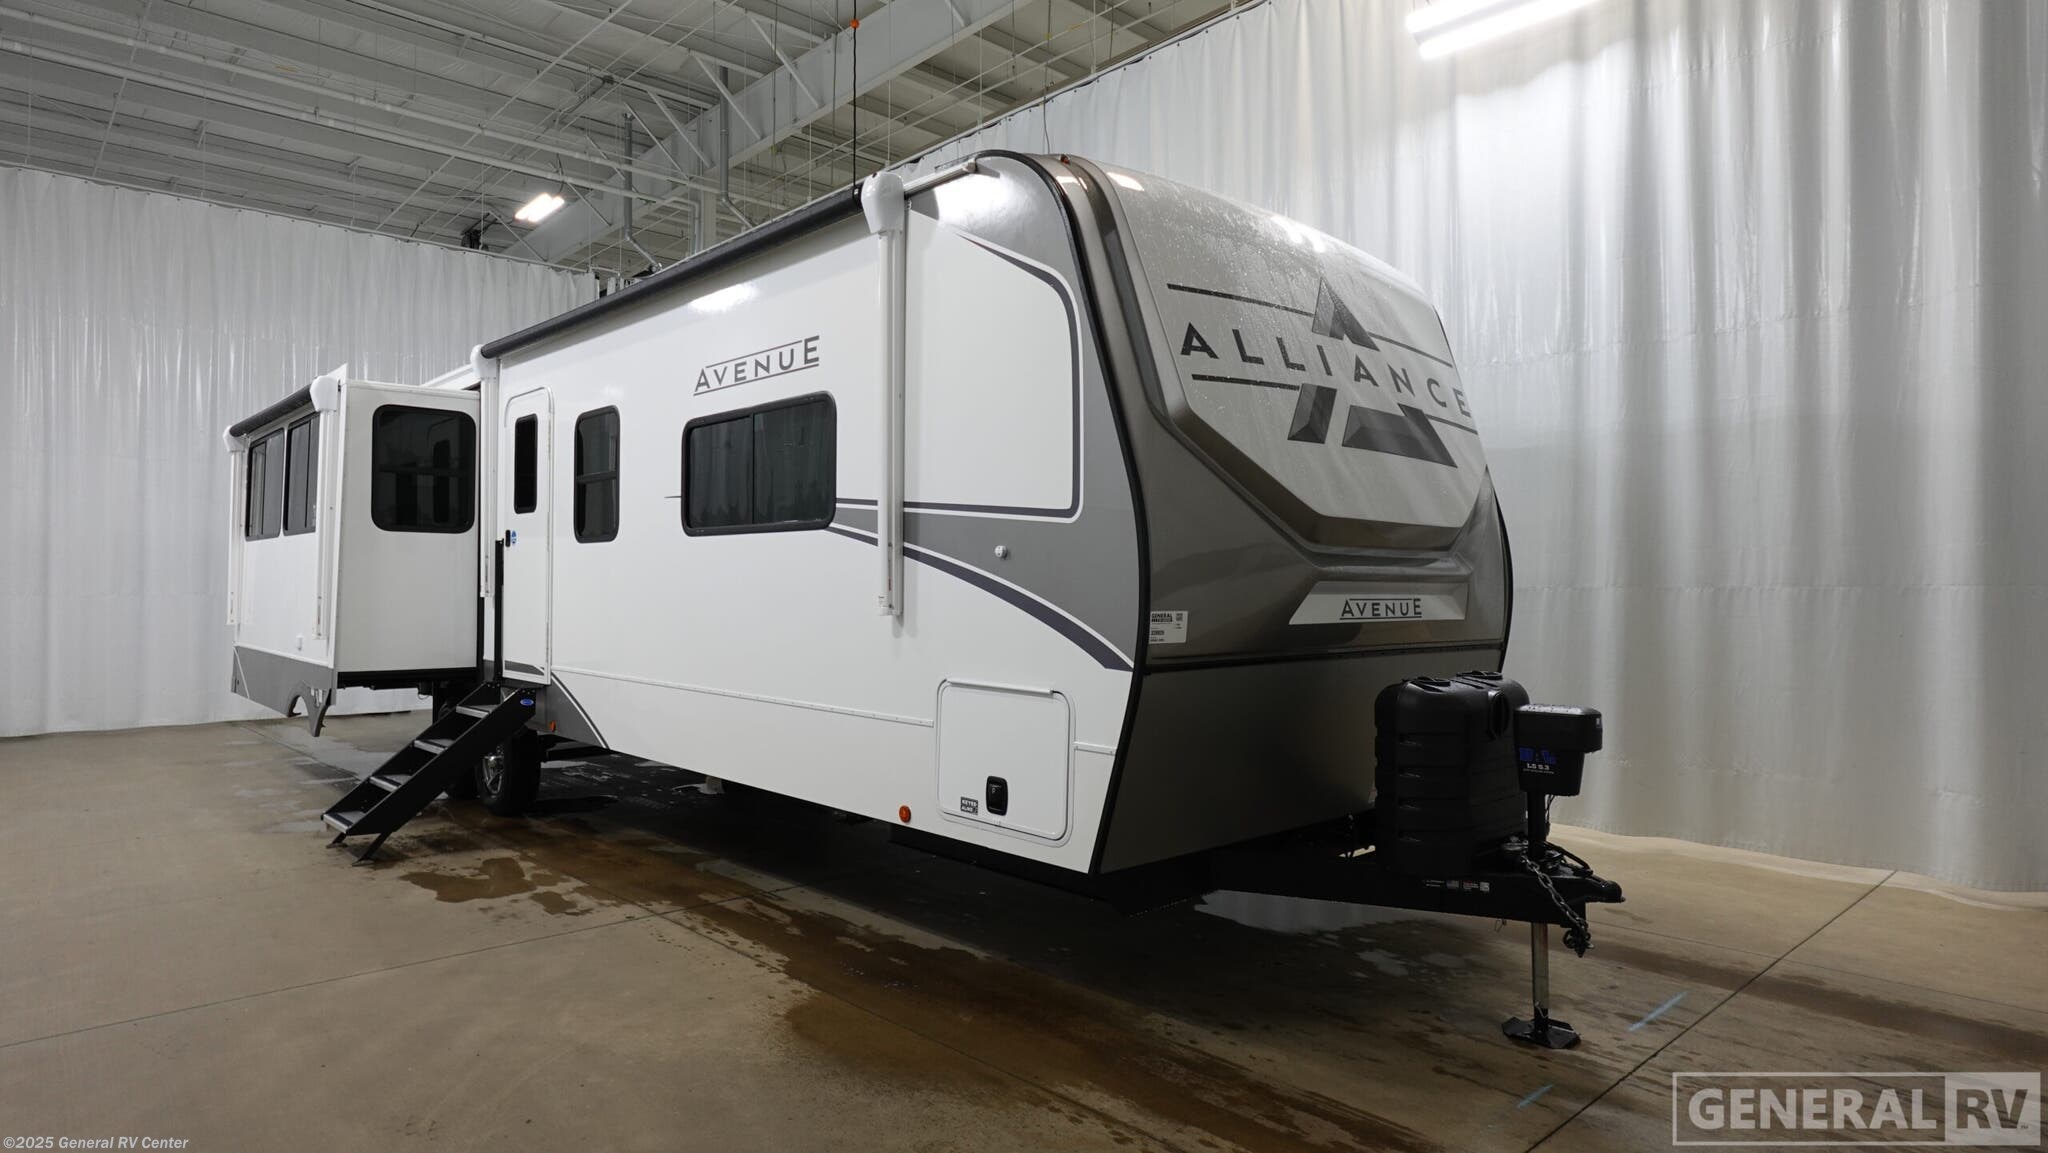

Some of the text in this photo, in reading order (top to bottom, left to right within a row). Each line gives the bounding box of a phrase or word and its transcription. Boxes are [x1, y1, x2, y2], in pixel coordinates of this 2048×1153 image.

[695, 335, 820, 392] AVENUE
[1180, 322, 1471, 417] ALLIANCE
[1341, 598, 1422, 617] AVENUE
